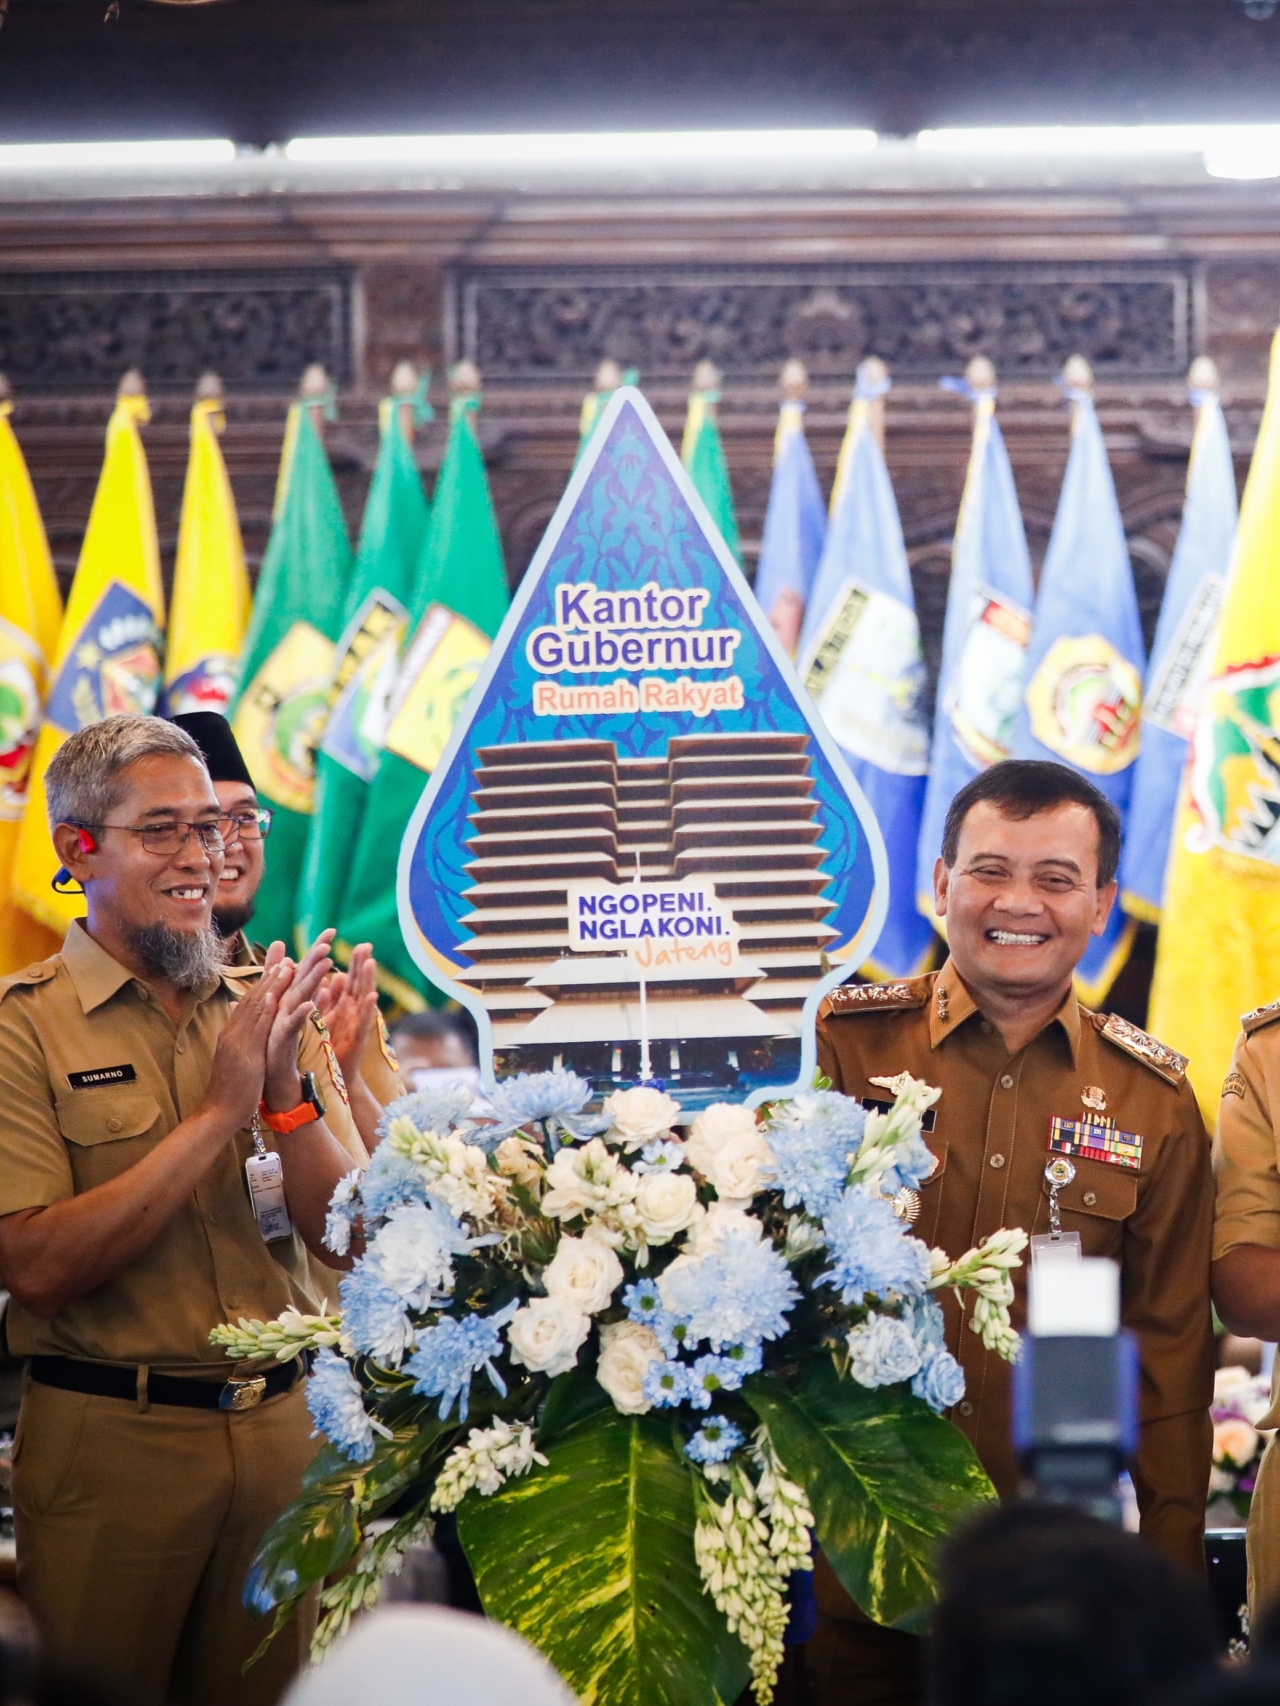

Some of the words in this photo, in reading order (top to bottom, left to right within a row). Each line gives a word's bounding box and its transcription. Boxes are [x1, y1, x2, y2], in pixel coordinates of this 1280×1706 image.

[561, 588, 704, 626] Kantor
[532, 630, 735, 668] Gubernur
[538, 683, 635, 711] Rumah
[644, 681, 740, 712] Rakyat
[578, 892, 713, 916] NGOPENI.
[579, 915, 731, 941] NGLAKONI.
[634, 935, 733, 968] Jateng
[82, 1070, 123, 1082] SUMARNO
